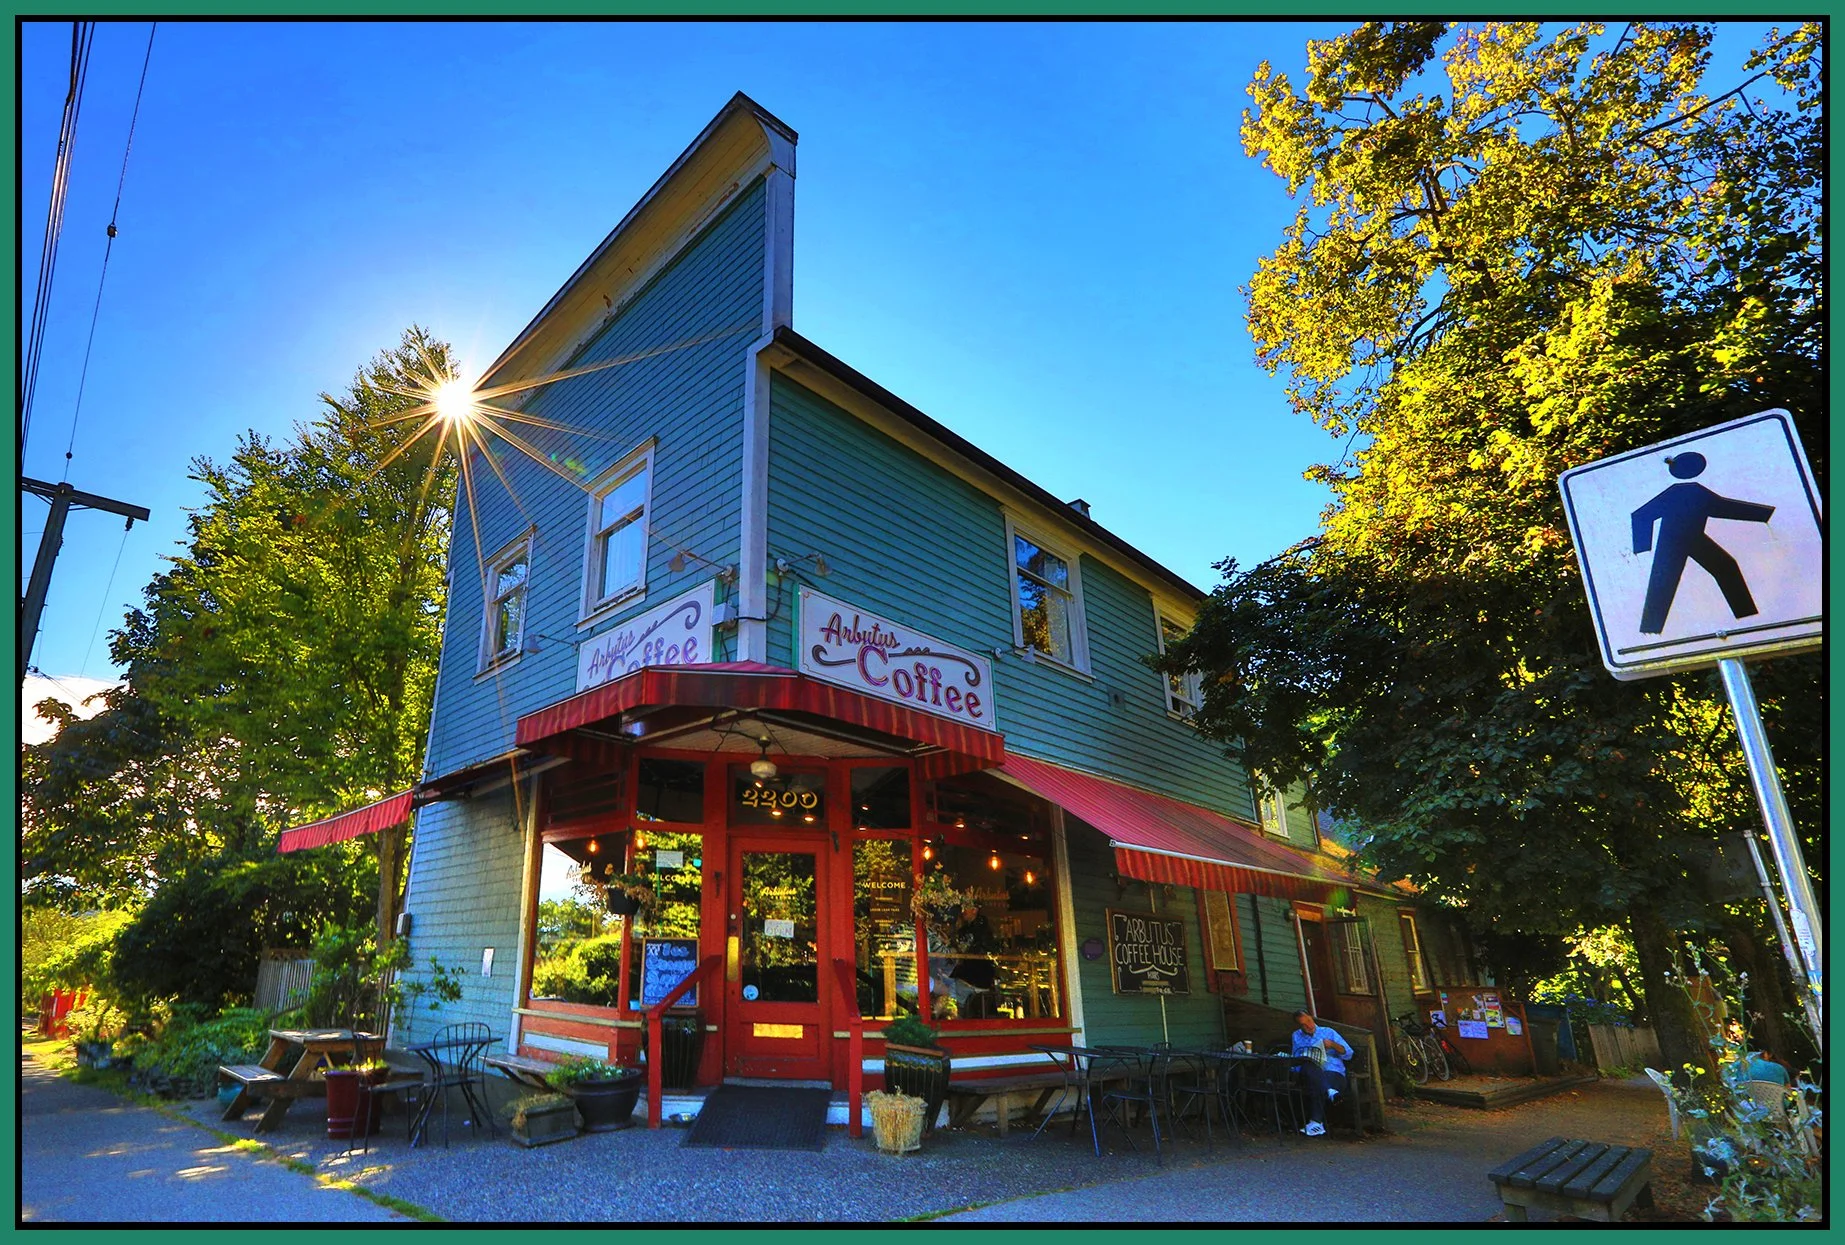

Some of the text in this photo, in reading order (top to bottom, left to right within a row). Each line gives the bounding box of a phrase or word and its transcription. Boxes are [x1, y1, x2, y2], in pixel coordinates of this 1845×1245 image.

[819, 612, 900, 648] Arbutus
[587, 630, 635, 679] Arbutus
[857, 645, 982, 718] Coffee
[742, 789, 818, 809] 2200
[864, 881, 906, 889] WELCOME
[1126, 918, 1174, 946] ARBUTUS
[1115, 943, 1184, 966] COFFEE HOUSE
